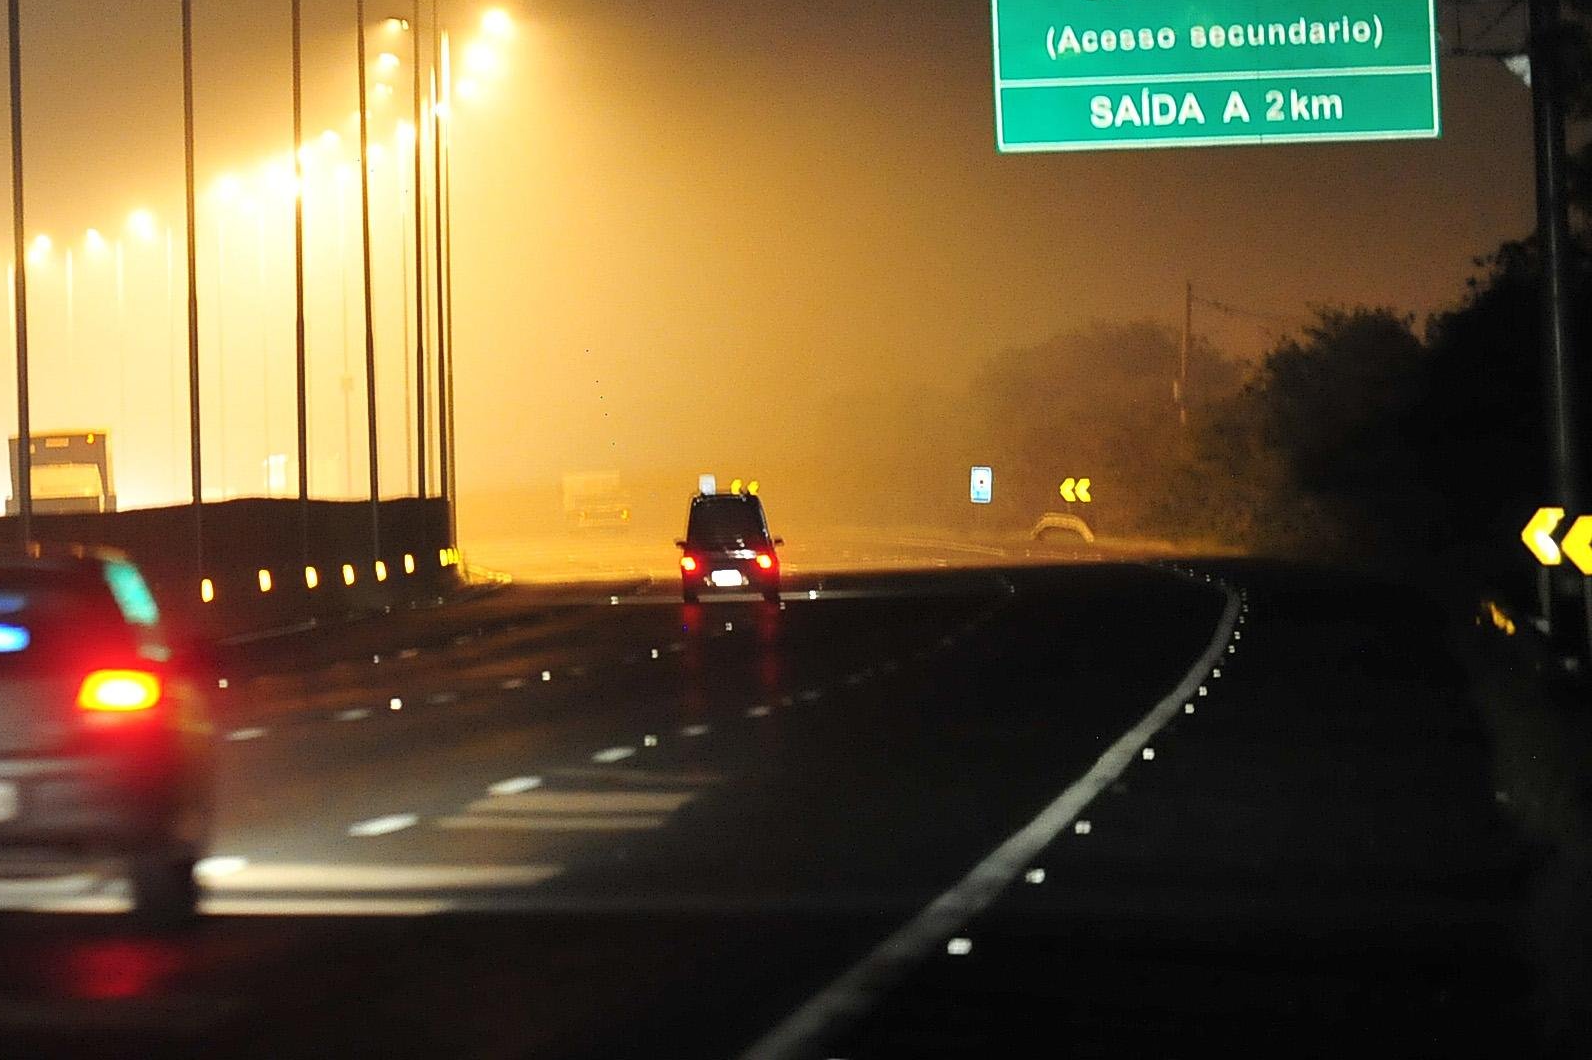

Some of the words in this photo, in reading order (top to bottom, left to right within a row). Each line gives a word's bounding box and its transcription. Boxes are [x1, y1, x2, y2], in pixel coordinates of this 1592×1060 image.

[1046, 25, 1176, 60] (Acesso
[1090, 88, 1205, 129] SAÍDA
[1223, 91, 1250, 123] A
